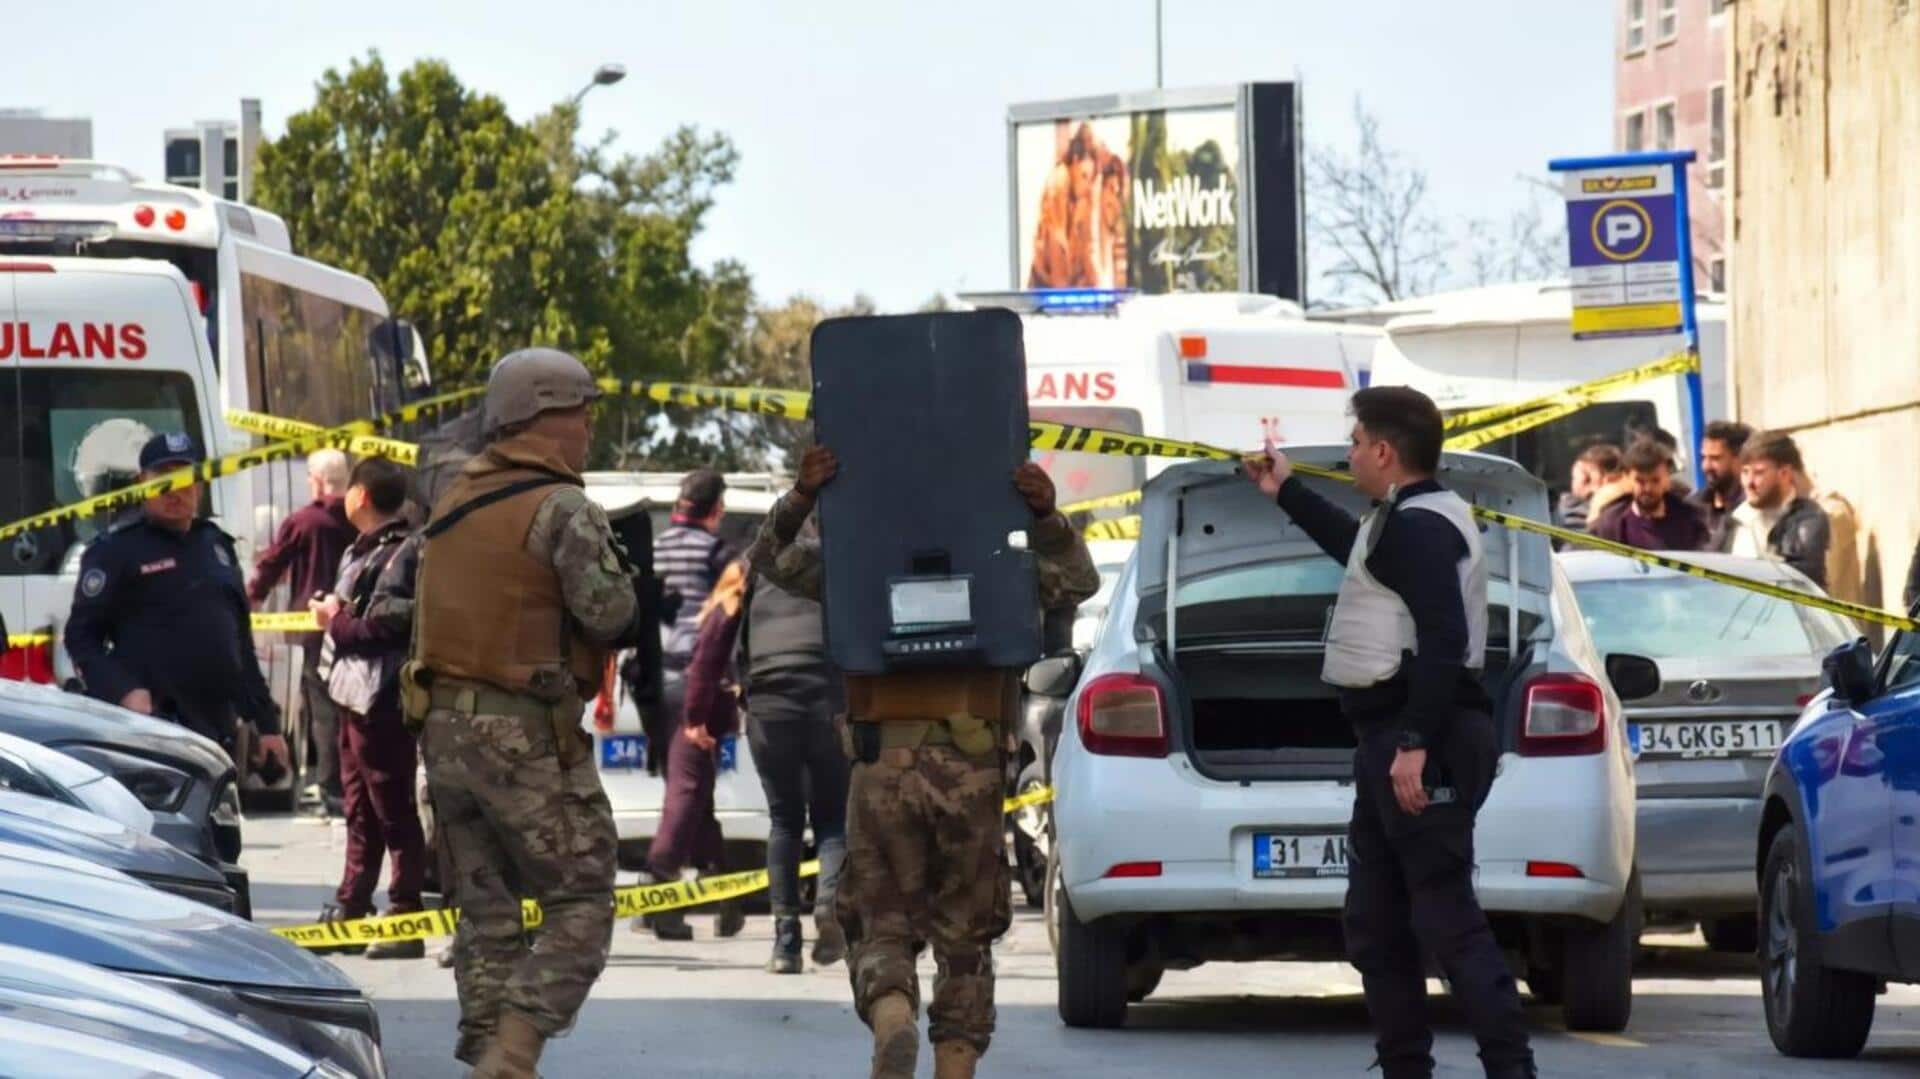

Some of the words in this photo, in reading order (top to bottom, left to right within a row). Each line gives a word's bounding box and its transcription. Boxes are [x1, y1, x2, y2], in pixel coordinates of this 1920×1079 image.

[1133, 174, 1235, 229] NetWork
[1605, 214, 1642, 247] P
[1641, 727, 1672, 750] 34
[1731, 723, 1776, 748] 511
[1271, 838, 1299, 864] 31
